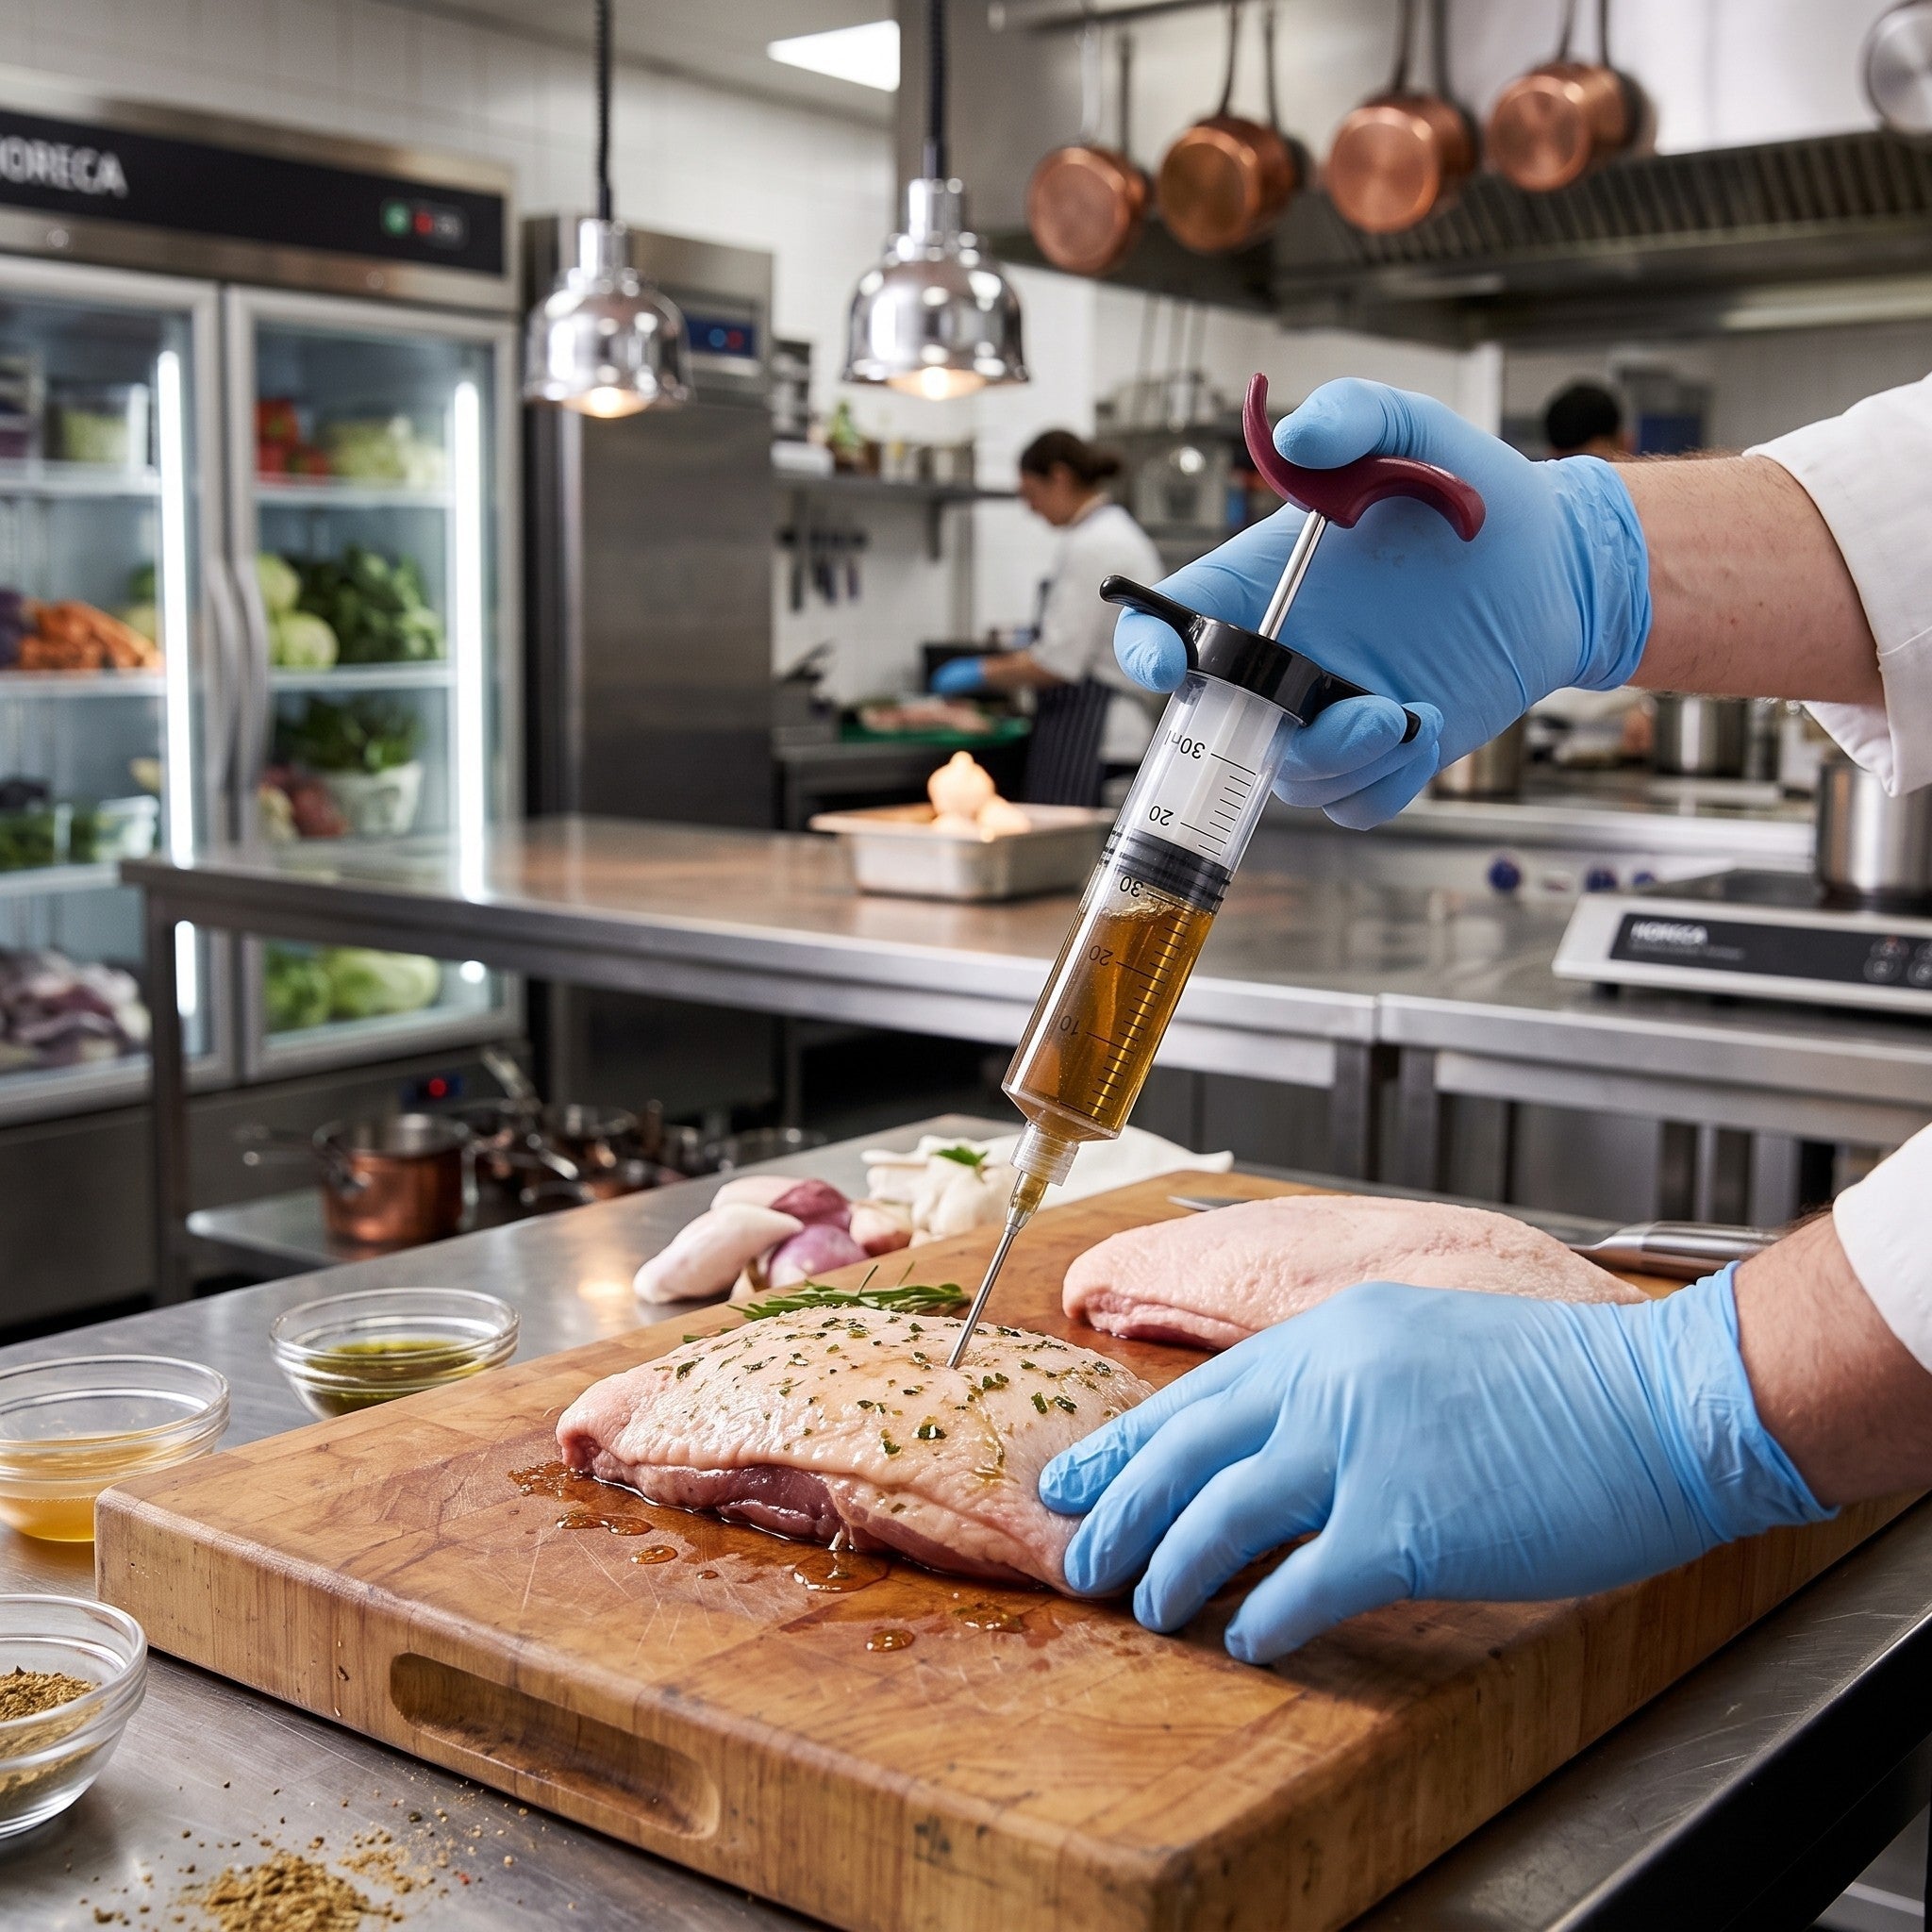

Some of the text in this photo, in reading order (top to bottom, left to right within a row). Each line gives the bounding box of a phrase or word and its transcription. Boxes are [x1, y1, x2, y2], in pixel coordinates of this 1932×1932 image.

[0, 135, 128, 198] ORECA
[1148, 806, 1174, 826] 20
[1119, 875, 1144, 897] 30
[1089, 945, 1114, 967] 20
[1060, 1015, 1080, 1037] 10
